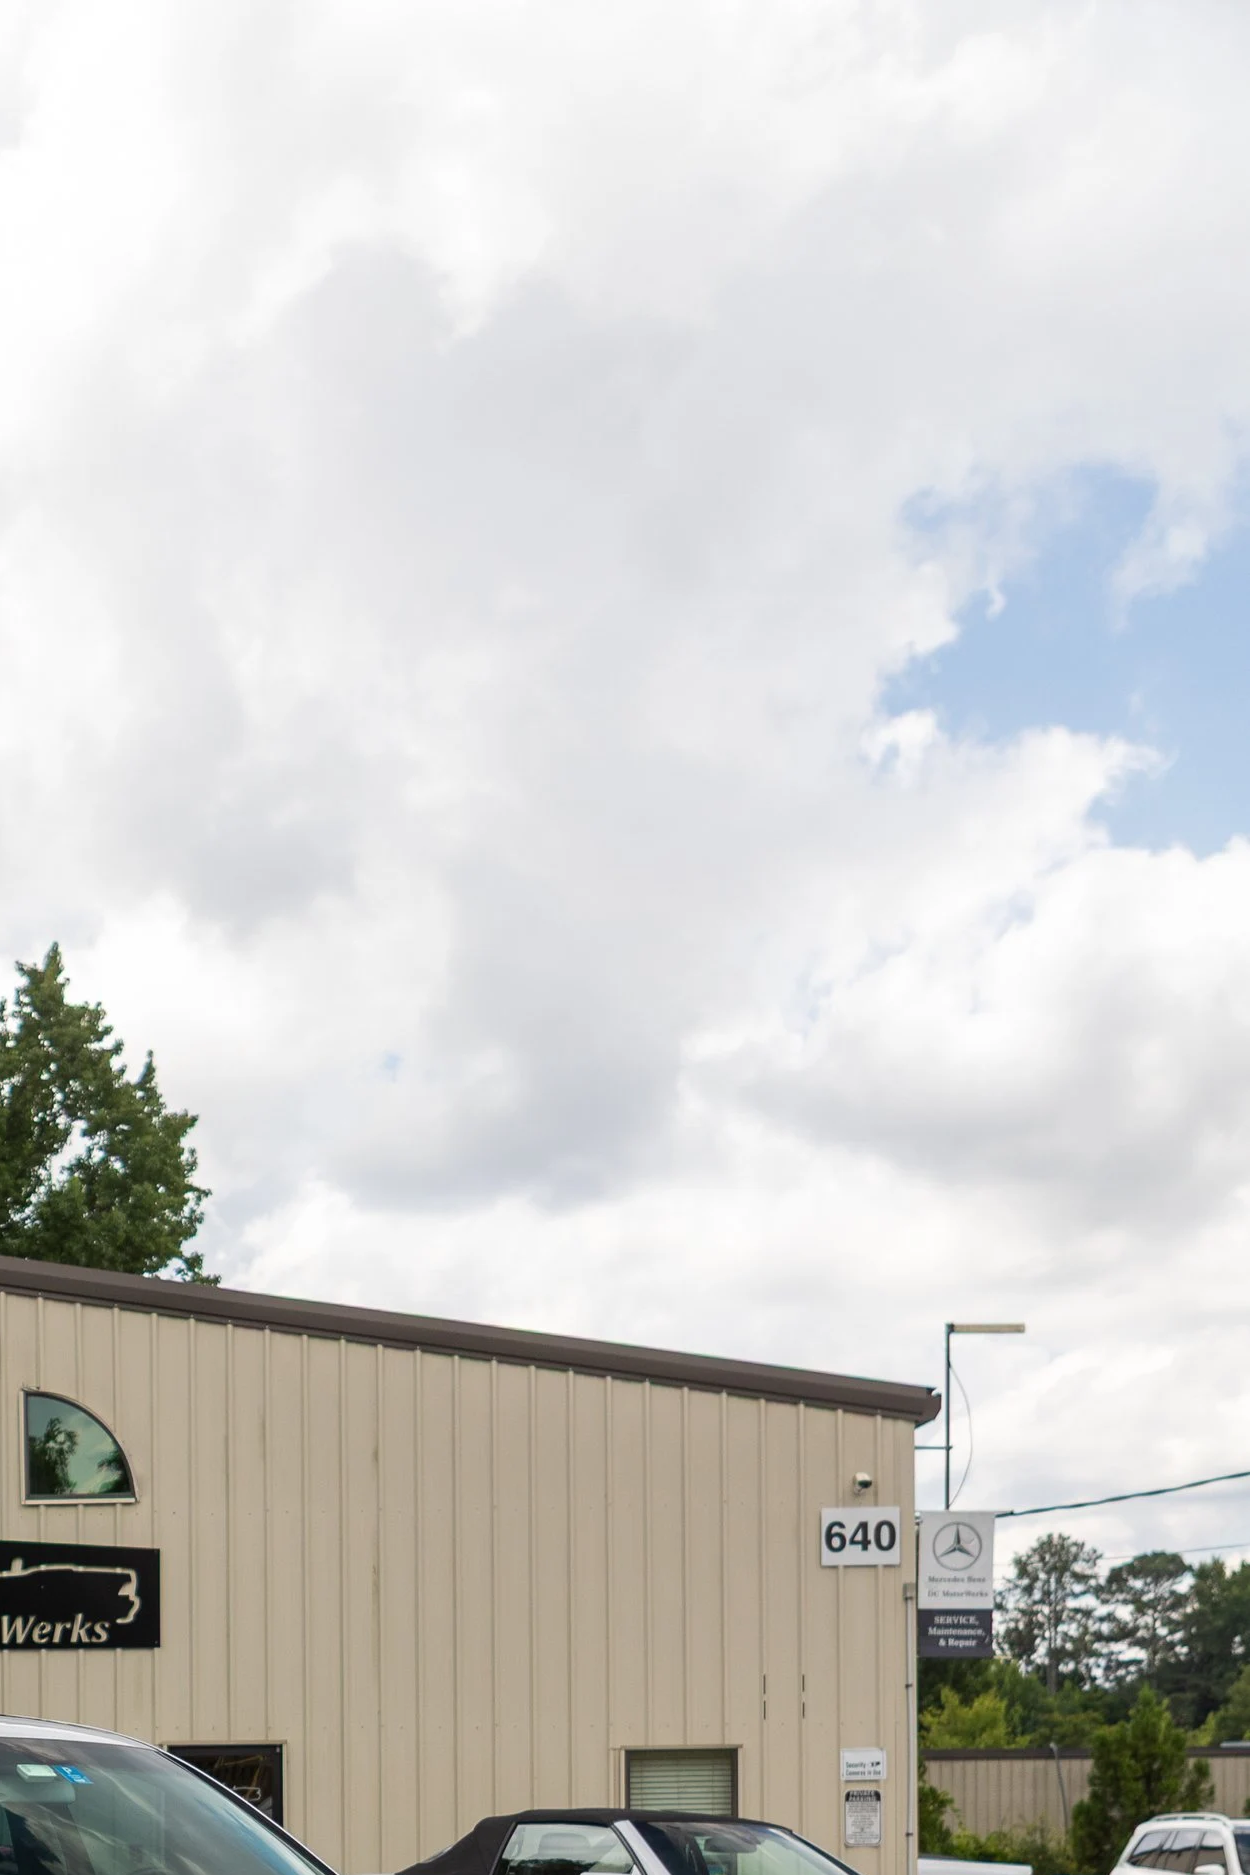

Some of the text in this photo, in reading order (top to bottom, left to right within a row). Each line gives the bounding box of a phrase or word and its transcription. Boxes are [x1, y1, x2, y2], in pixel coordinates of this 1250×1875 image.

[824, 1520, 896, 1552] 640
[938, 1638, 977, 1648] & Repair
